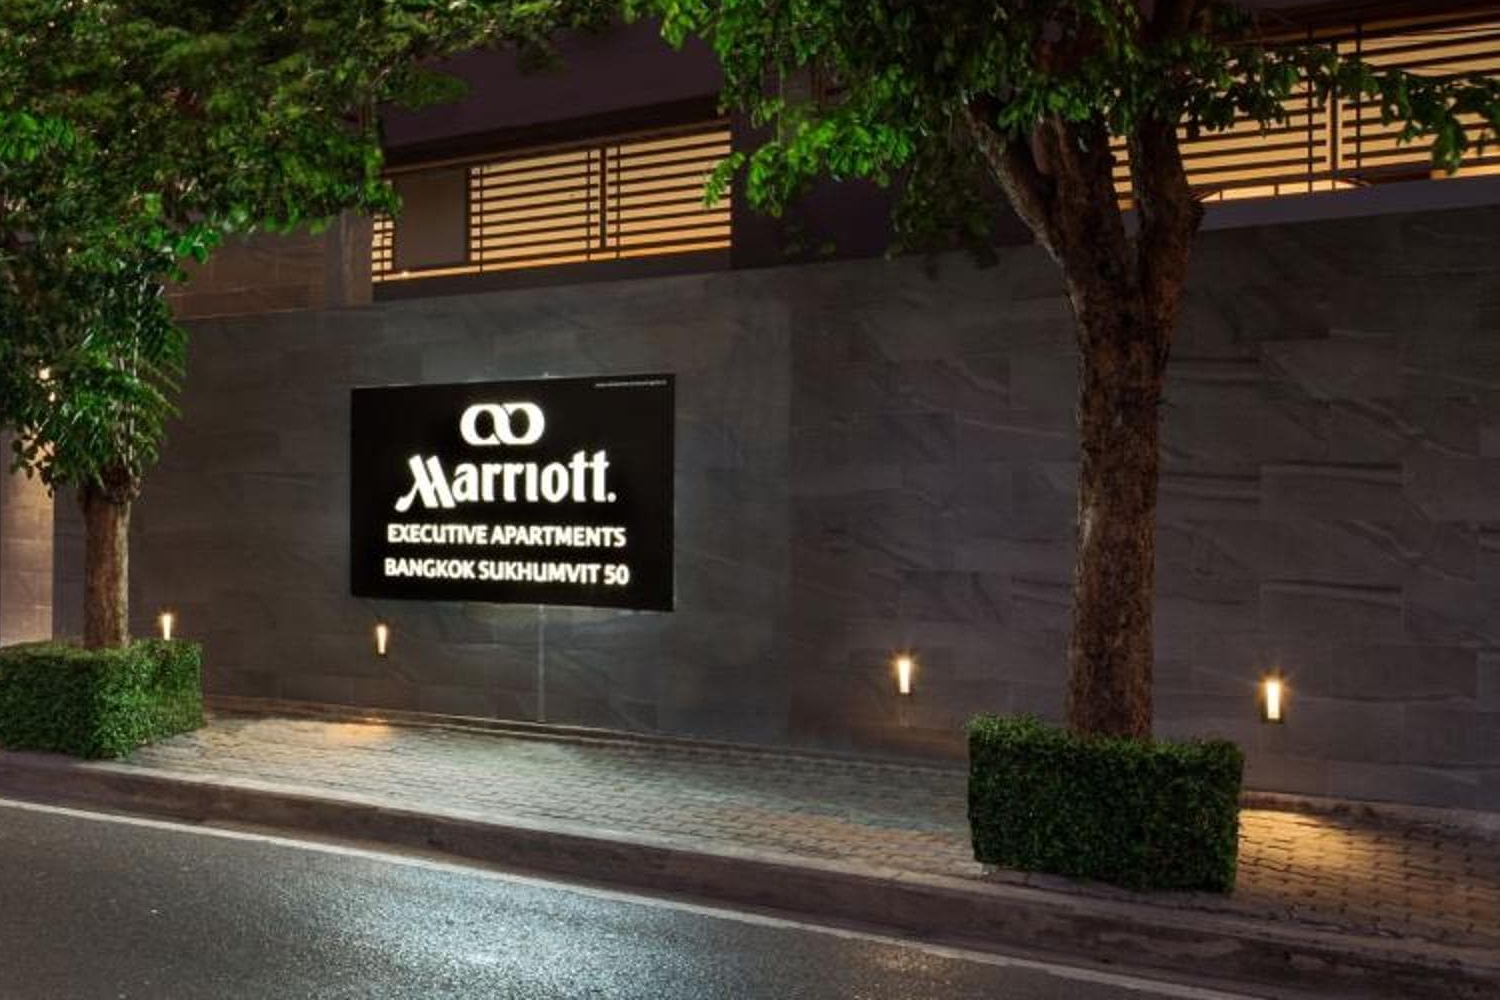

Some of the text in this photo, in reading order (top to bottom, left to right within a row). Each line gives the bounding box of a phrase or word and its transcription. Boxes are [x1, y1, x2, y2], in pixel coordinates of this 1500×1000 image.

[387, 523, 627, 548] EXECUTIVE APARTMENTS
[384, 557, 630, 586] BANGKOK SUKHUMVIT 50
